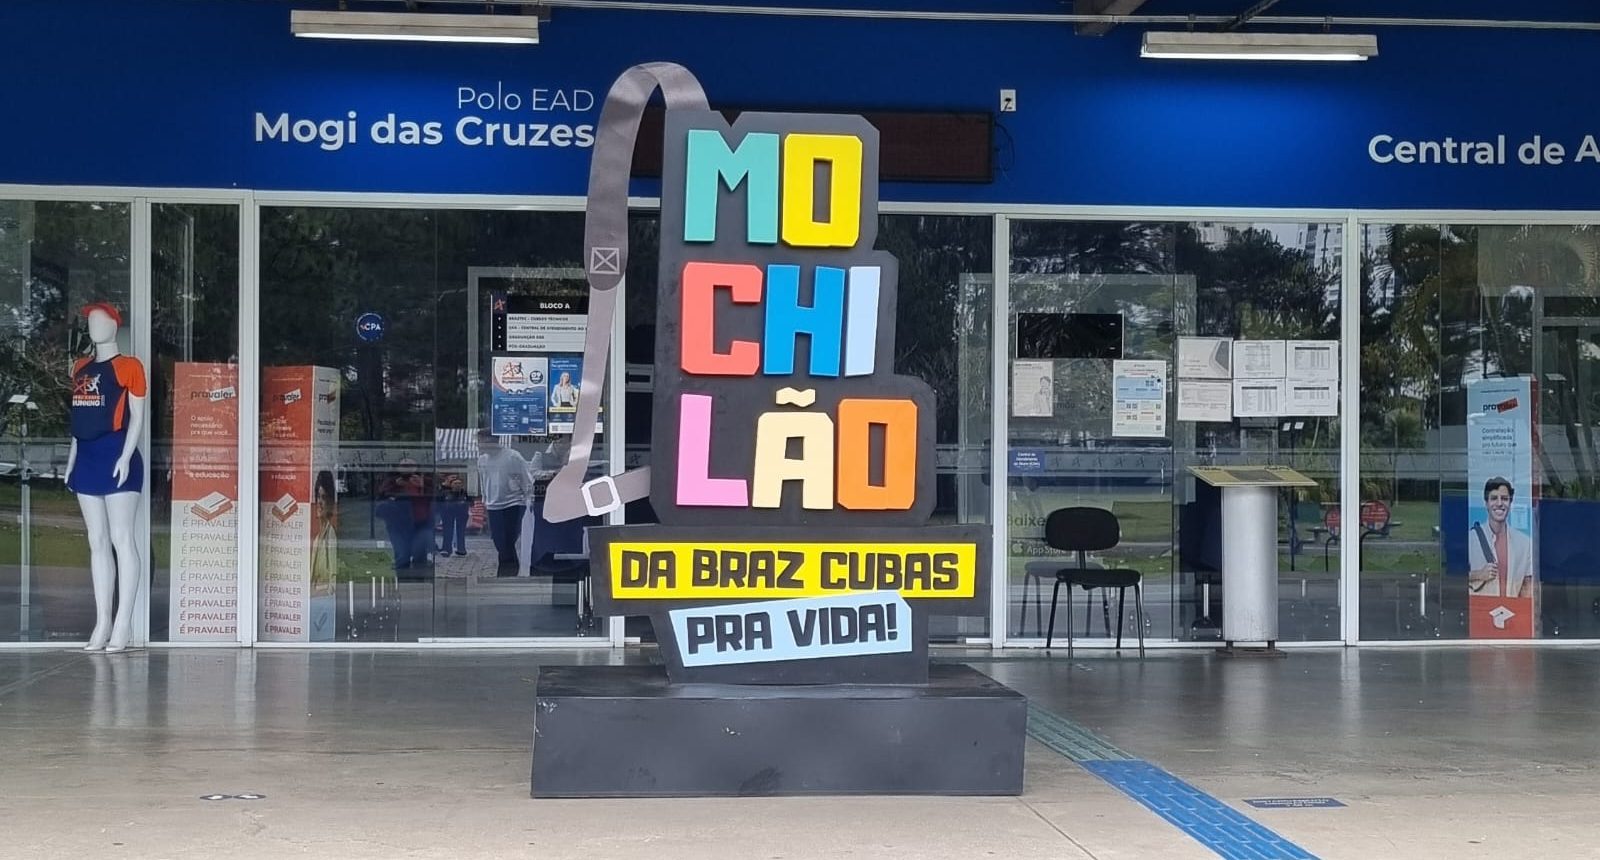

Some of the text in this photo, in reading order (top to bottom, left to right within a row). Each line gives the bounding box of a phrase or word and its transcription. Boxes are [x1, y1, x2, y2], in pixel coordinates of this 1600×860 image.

[458, 81, 595, 111] Polo EAD
[254, 110, 596, 151] Mogi das Cruzes
[1368, 134, 1600, 165] Central de A
[684, 129, 863, 248] MO
[680, 261, 881, 376] CHI
[676, 386, 918, 511] LÃO
[188, 573, 238, 581] PRAVALER
[621, 550, 959, 590] DA BRAZ CUBAS
[188, 586, 238, 595] PRAVALER
[188, 599, 238, 608] PRAVALER
[187, 613, 237, 621] PRAVALER
[187, 626, 237, 634] PRAVALER
[270, 612, 302, 622] PRAVALER
[270, 625, 302, 635] PRAVALER
[686, 603, 899, 654] PRA VIDA!
